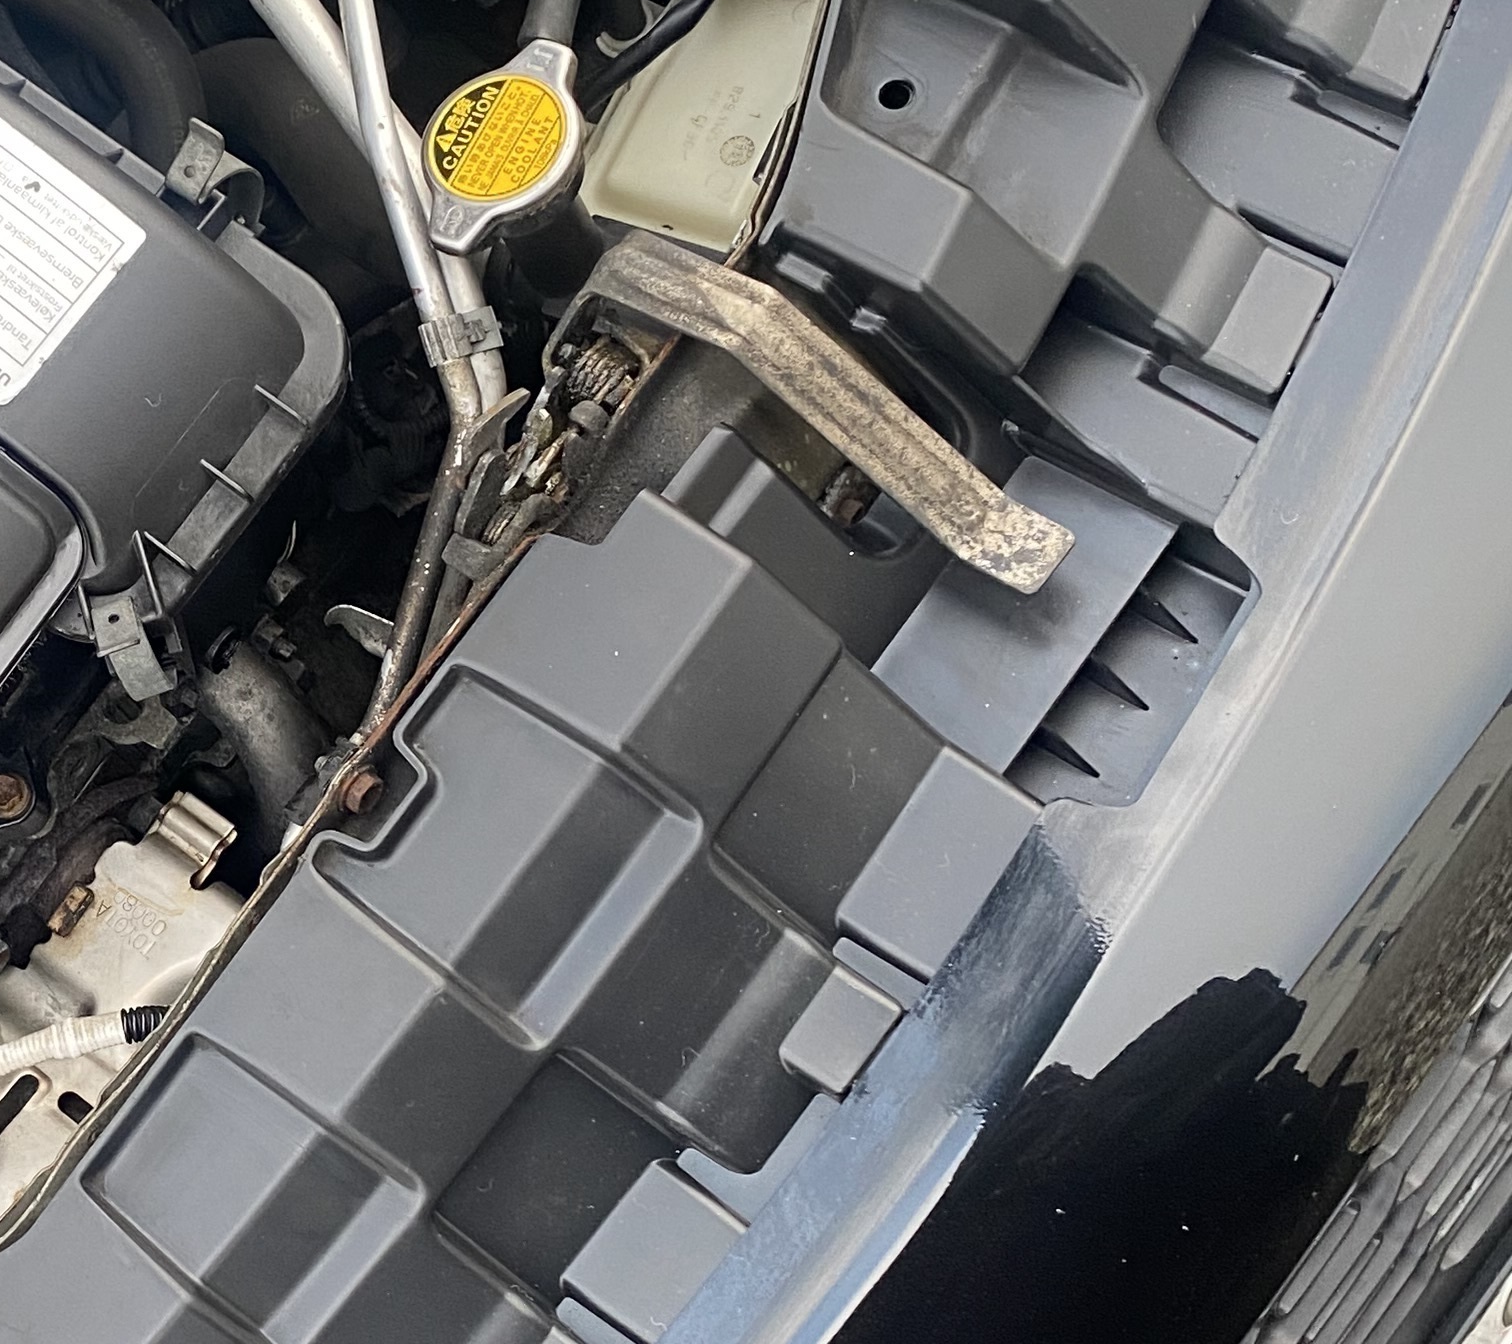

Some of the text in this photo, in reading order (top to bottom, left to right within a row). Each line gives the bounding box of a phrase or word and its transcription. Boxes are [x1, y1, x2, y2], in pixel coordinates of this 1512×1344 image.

[441, 83, 499, 172] CAUTION
[442, 93, 476, 136] 危険
[466, 157, 488, 188] NEVER
[484, 133, 503, 159] OPEN
[502, 115, 541, 175] ENGINE
[509, 115, 554, 184] COOLANT
[0, 220, 85, 290] Bremsevæske
[61, 224, 107, 262] Kontrol
[14, 270, 65, 312] Frostsikret
[89, 897, 163, 961] TOYOTA
